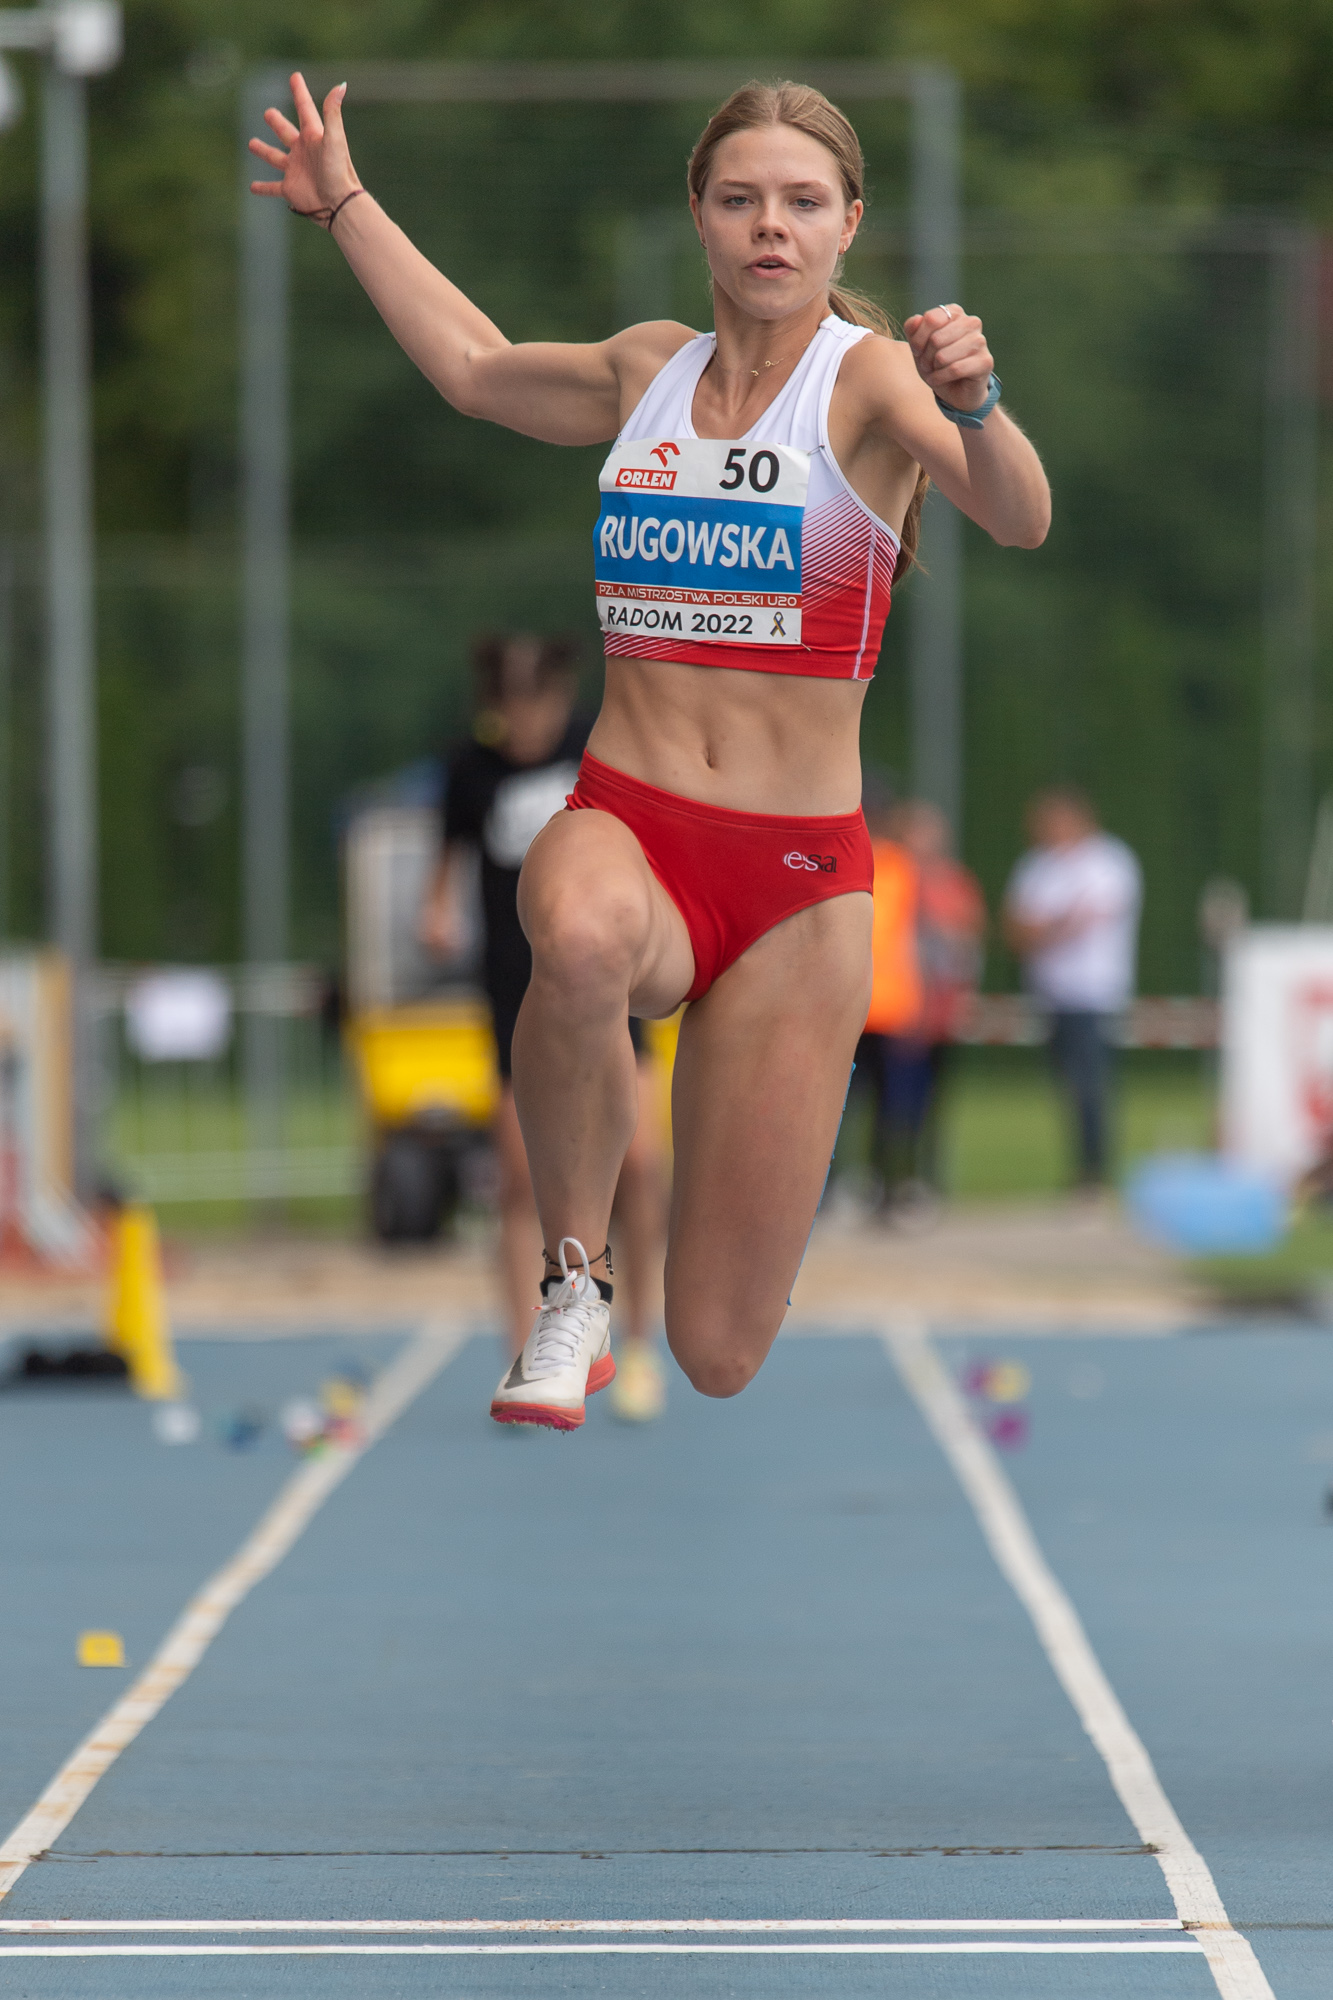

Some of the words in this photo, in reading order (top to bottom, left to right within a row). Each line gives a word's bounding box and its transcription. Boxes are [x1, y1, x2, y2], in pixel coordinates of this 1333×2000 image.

[618, 470, 674, 488] ORLEN
[719, 448, 780, 493] 50
[600, 515, 795, 571] RUGOWSKA
[600, 584, 625, 597] PZLA
[627, 587, 710, 604] MISTRZOSTWA
[713, 593, 763, 606] POLSKI
[767, 596, 797, 607] U20
[607, 605, 682, 631] RADOM
[691, 613, 753, 635] 2022
